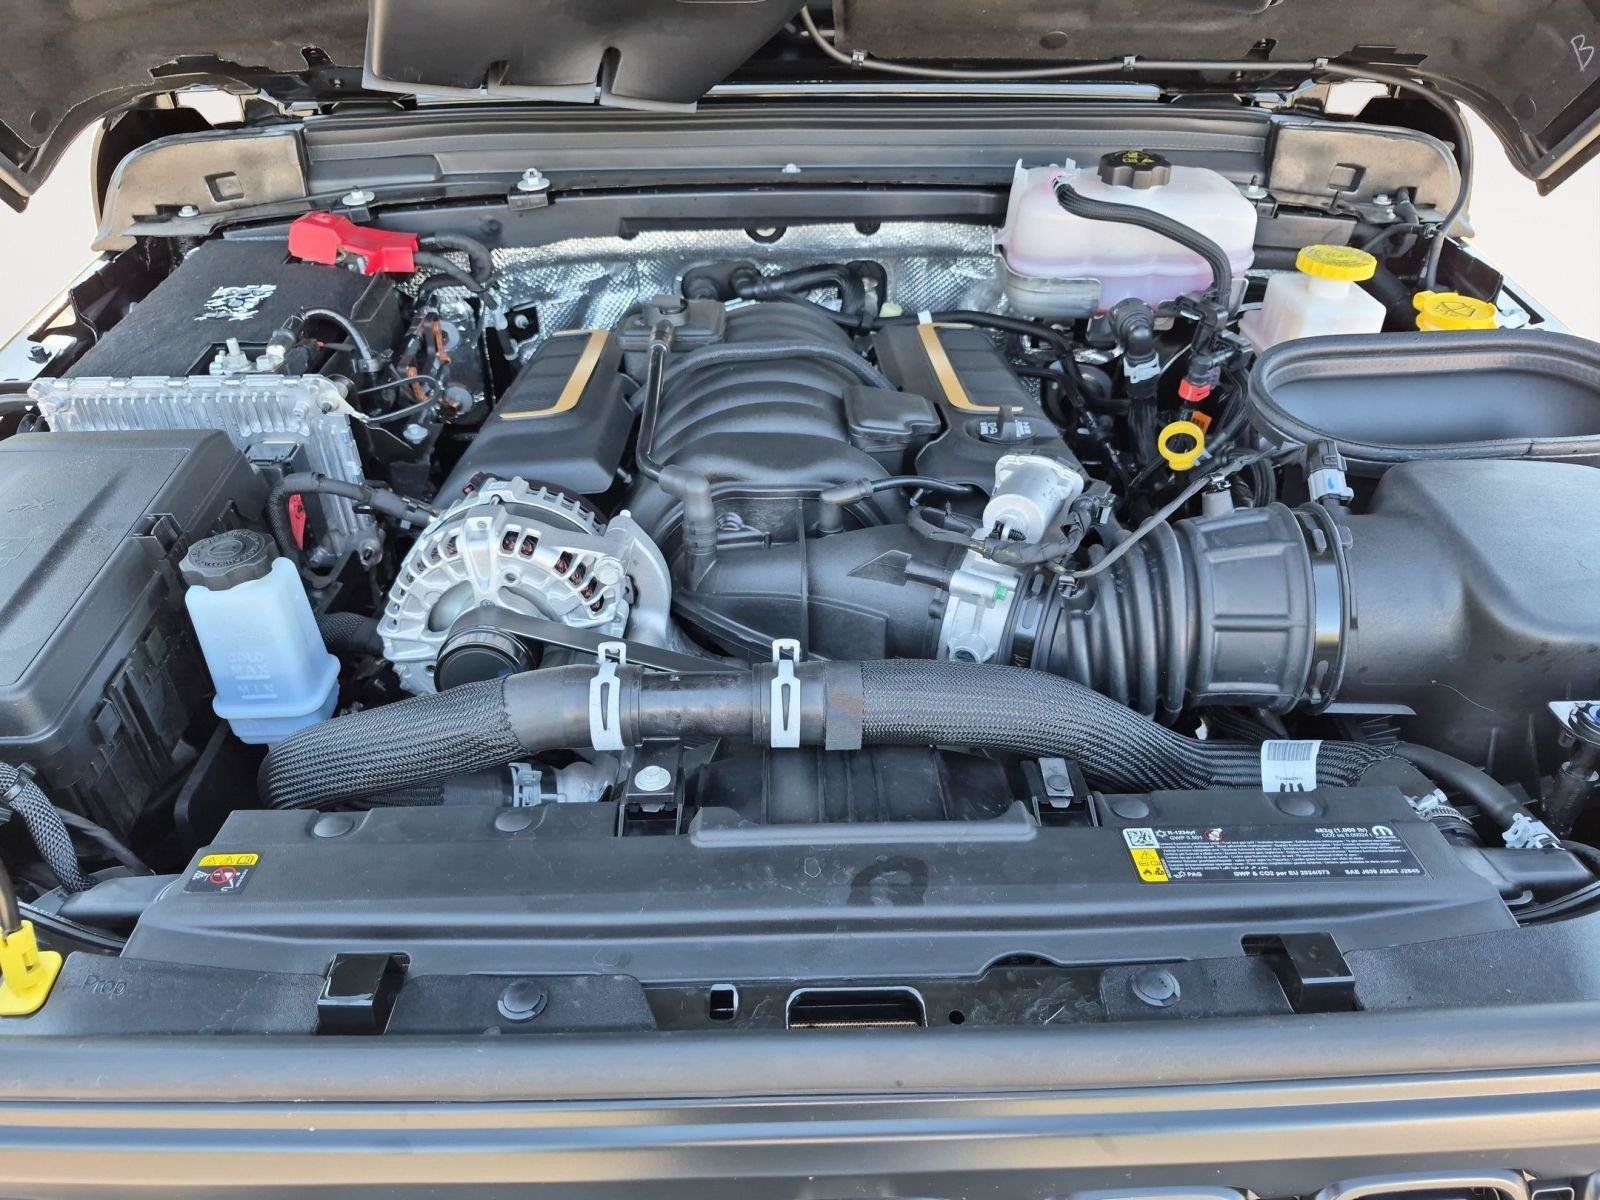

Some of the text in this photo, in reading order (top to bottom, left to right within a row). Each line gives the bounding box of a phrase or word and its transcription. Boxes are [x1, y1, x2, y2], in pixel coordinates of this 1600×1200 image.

[1570, 34, 1594, 71] B
[237, 684, 274, 694] MIN
[81, 974, 128, 1000] Prop
